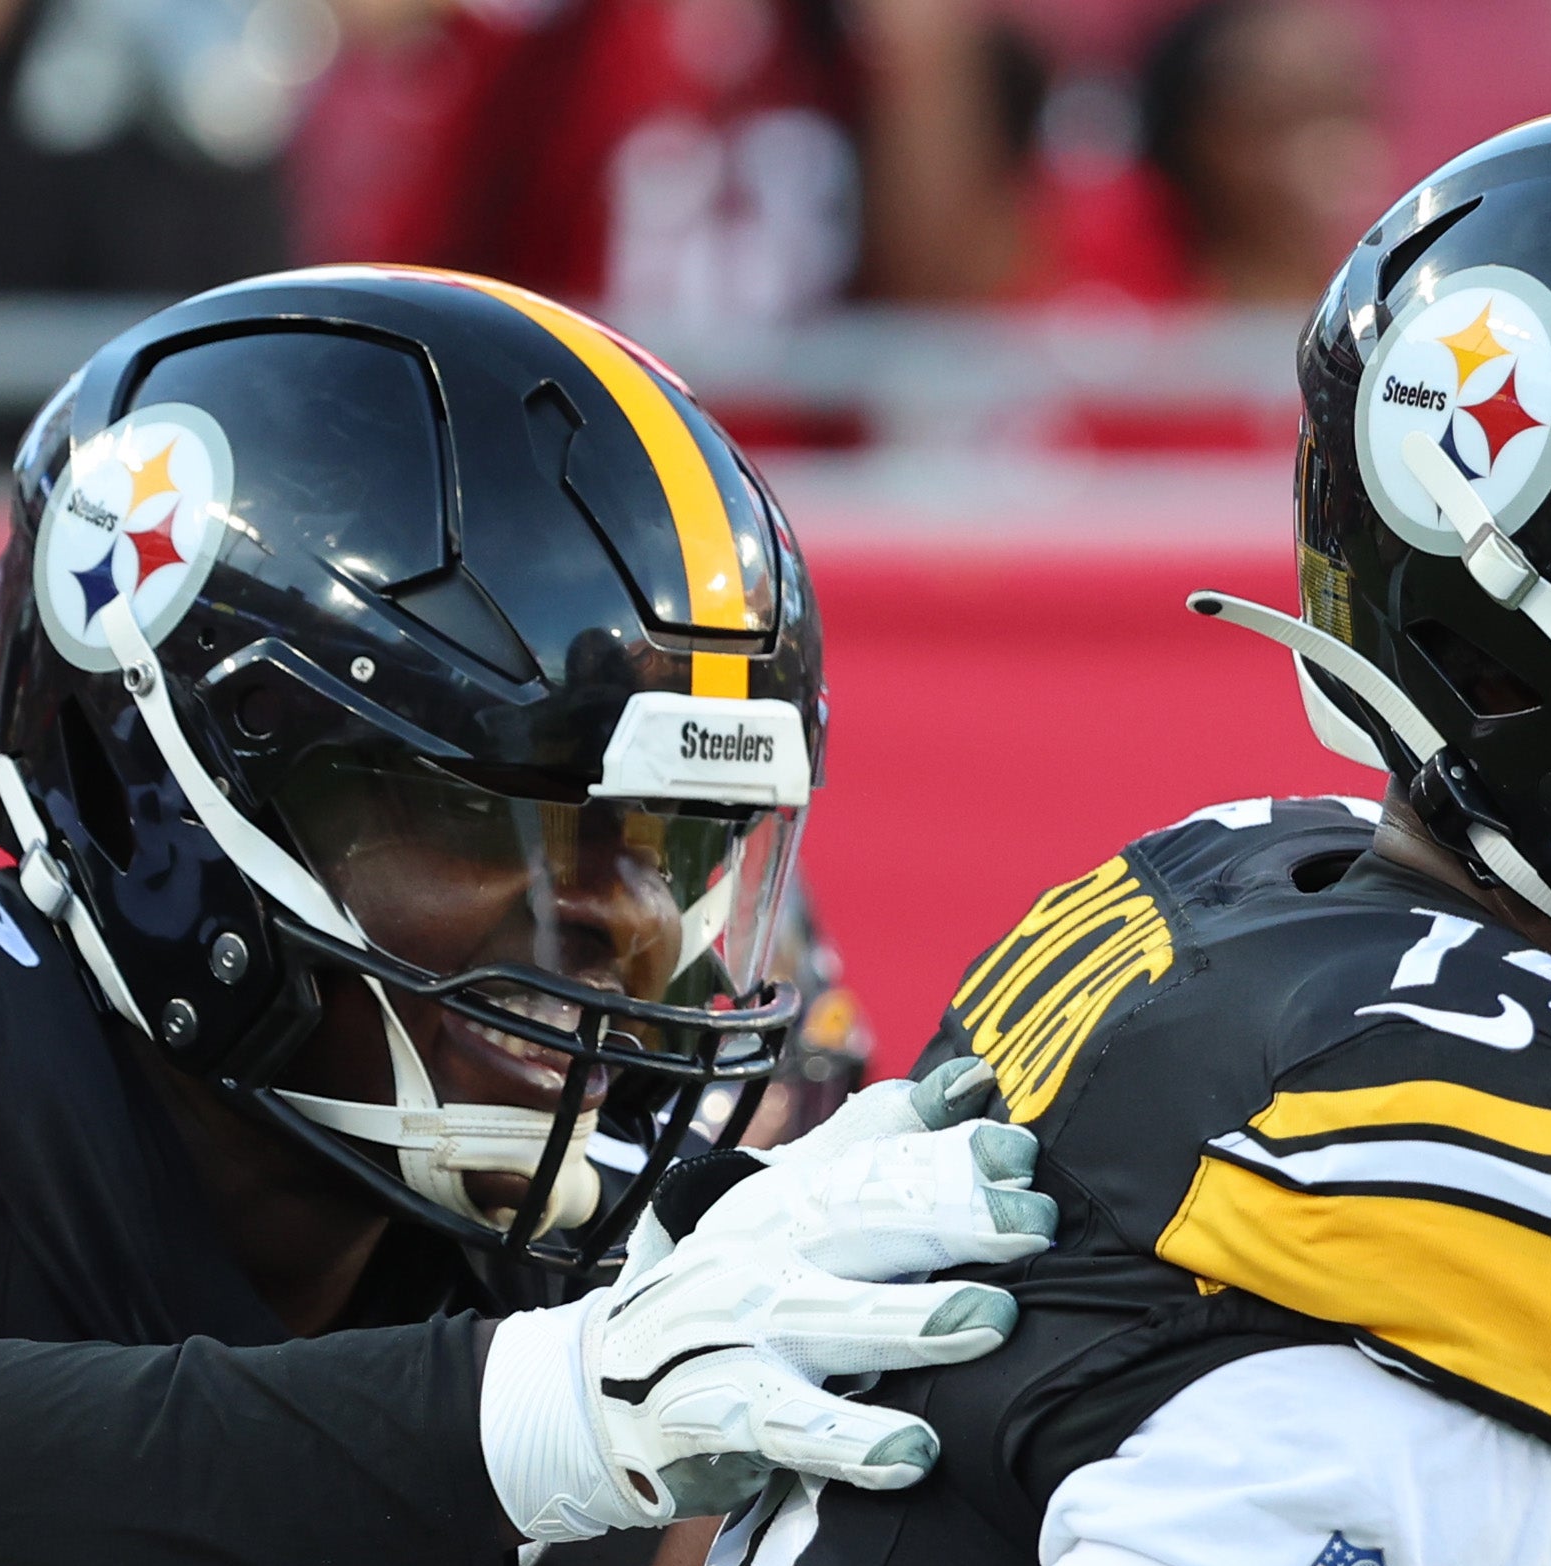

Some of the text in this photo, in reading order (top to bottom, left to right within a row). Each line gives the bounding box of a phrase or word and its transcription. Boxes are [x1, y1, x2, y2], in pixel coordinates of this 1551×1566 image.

[1382, 374, 1447, 412] Steelers
[66, 488, 119, 532] Steelers
[680, 720, 774, 763] Steelers
